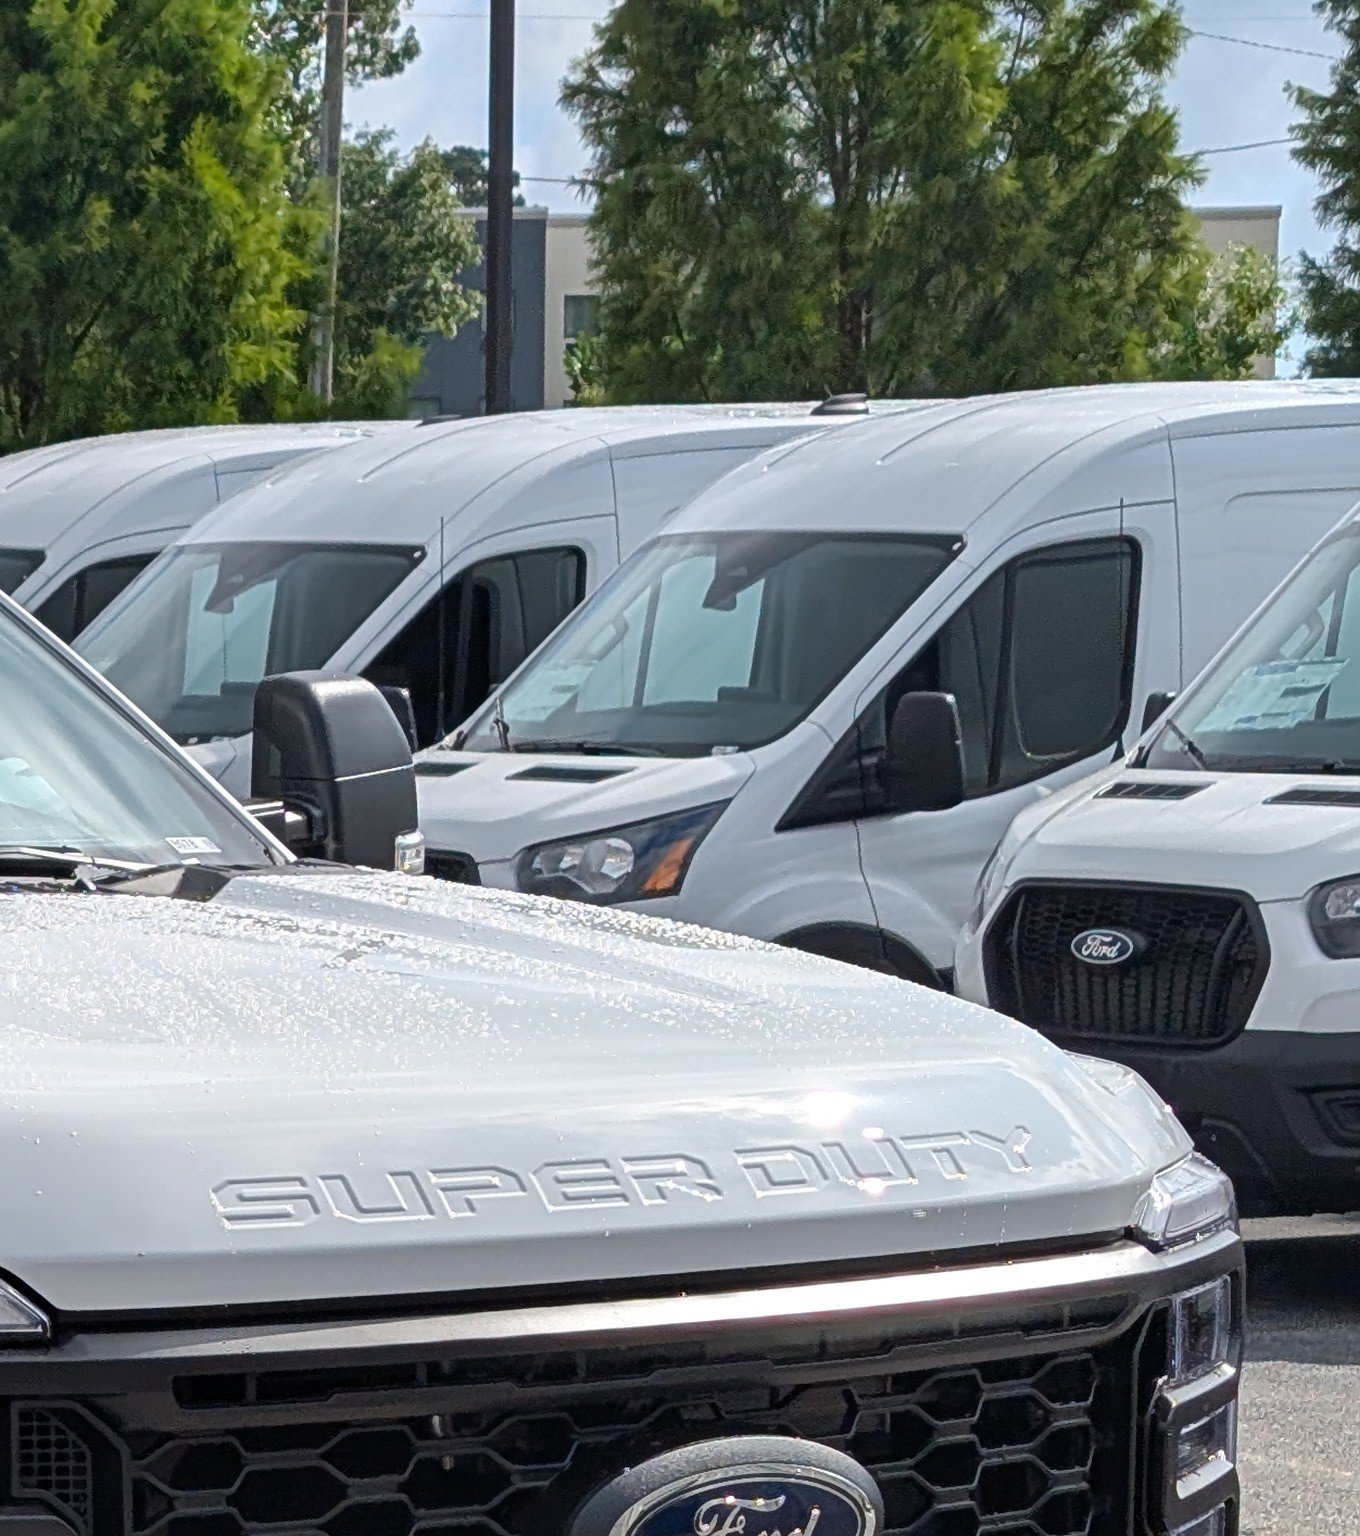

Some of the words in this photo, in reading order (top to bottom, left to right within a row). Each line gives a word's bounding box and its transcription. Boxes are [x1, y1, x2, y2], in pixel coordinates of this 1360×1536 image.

[1081, 934, 1122, 958] Ford
[209, 1153, 725, 1231] SUPER
[732, 1125, 1034, 1199] DUTY
